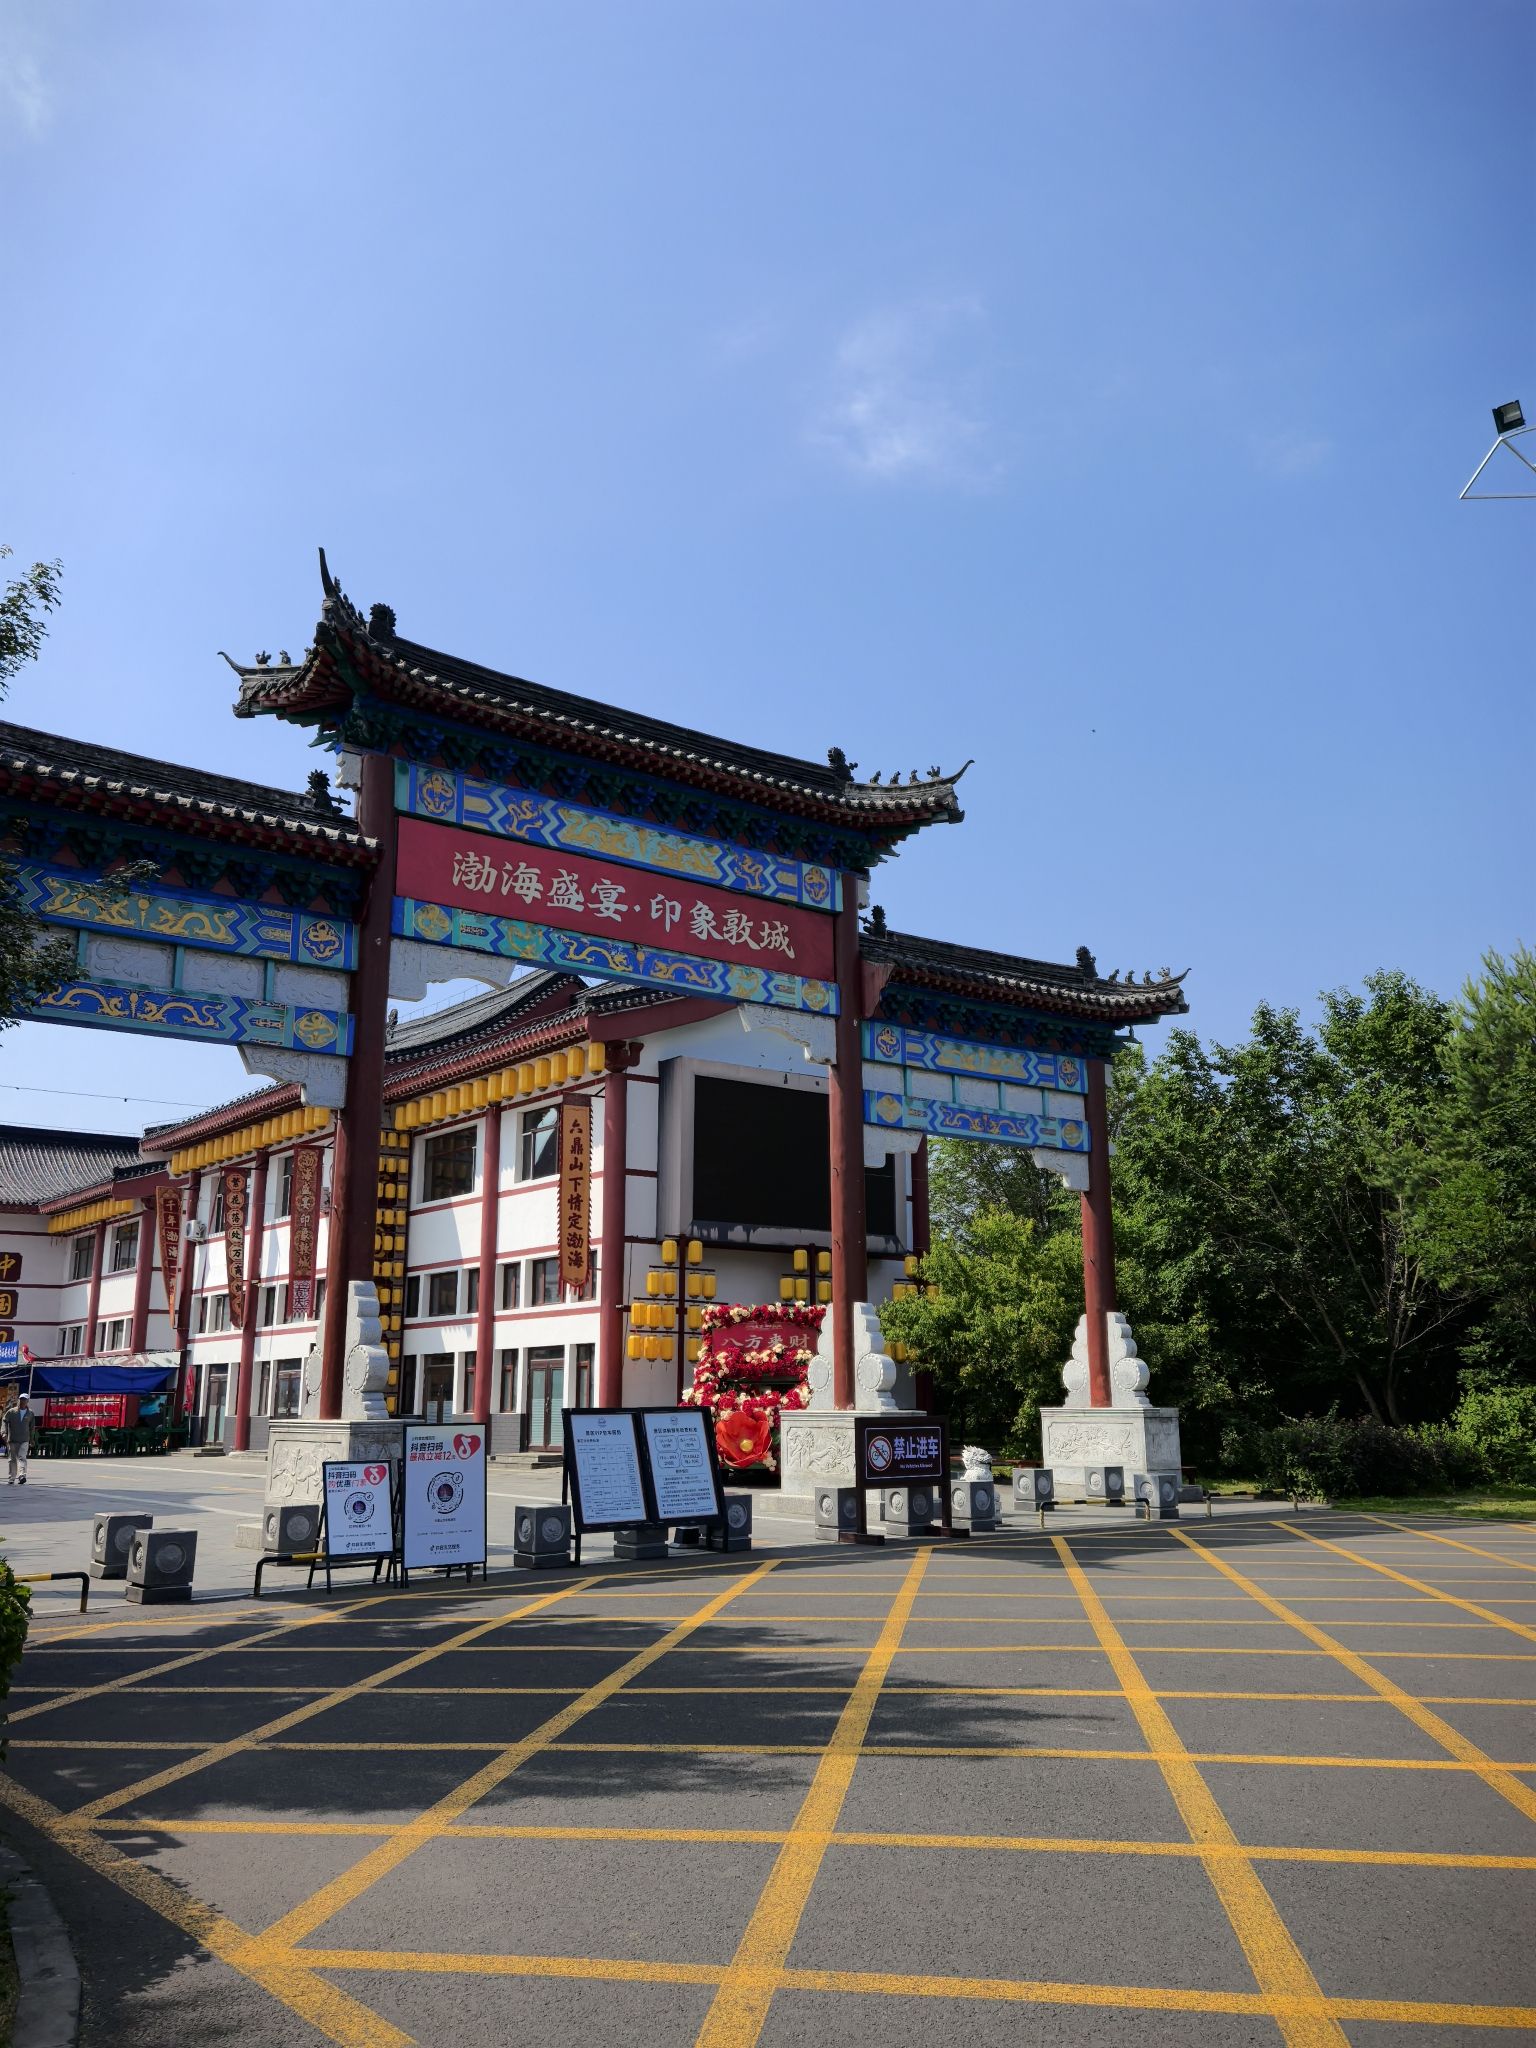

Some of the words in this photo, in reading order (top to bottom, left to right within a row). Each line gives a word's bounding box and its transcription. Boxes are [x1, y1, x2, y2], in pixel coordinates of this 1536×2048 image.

[566, 1118, 585, 1269] 六鼎山下情定渤海
[410, 1441, 443, 1451] 抖音扫码
[893, 1435, 939, 1460] 禁止进车
[328, 1471, 357, 1479] 抖音扫码
